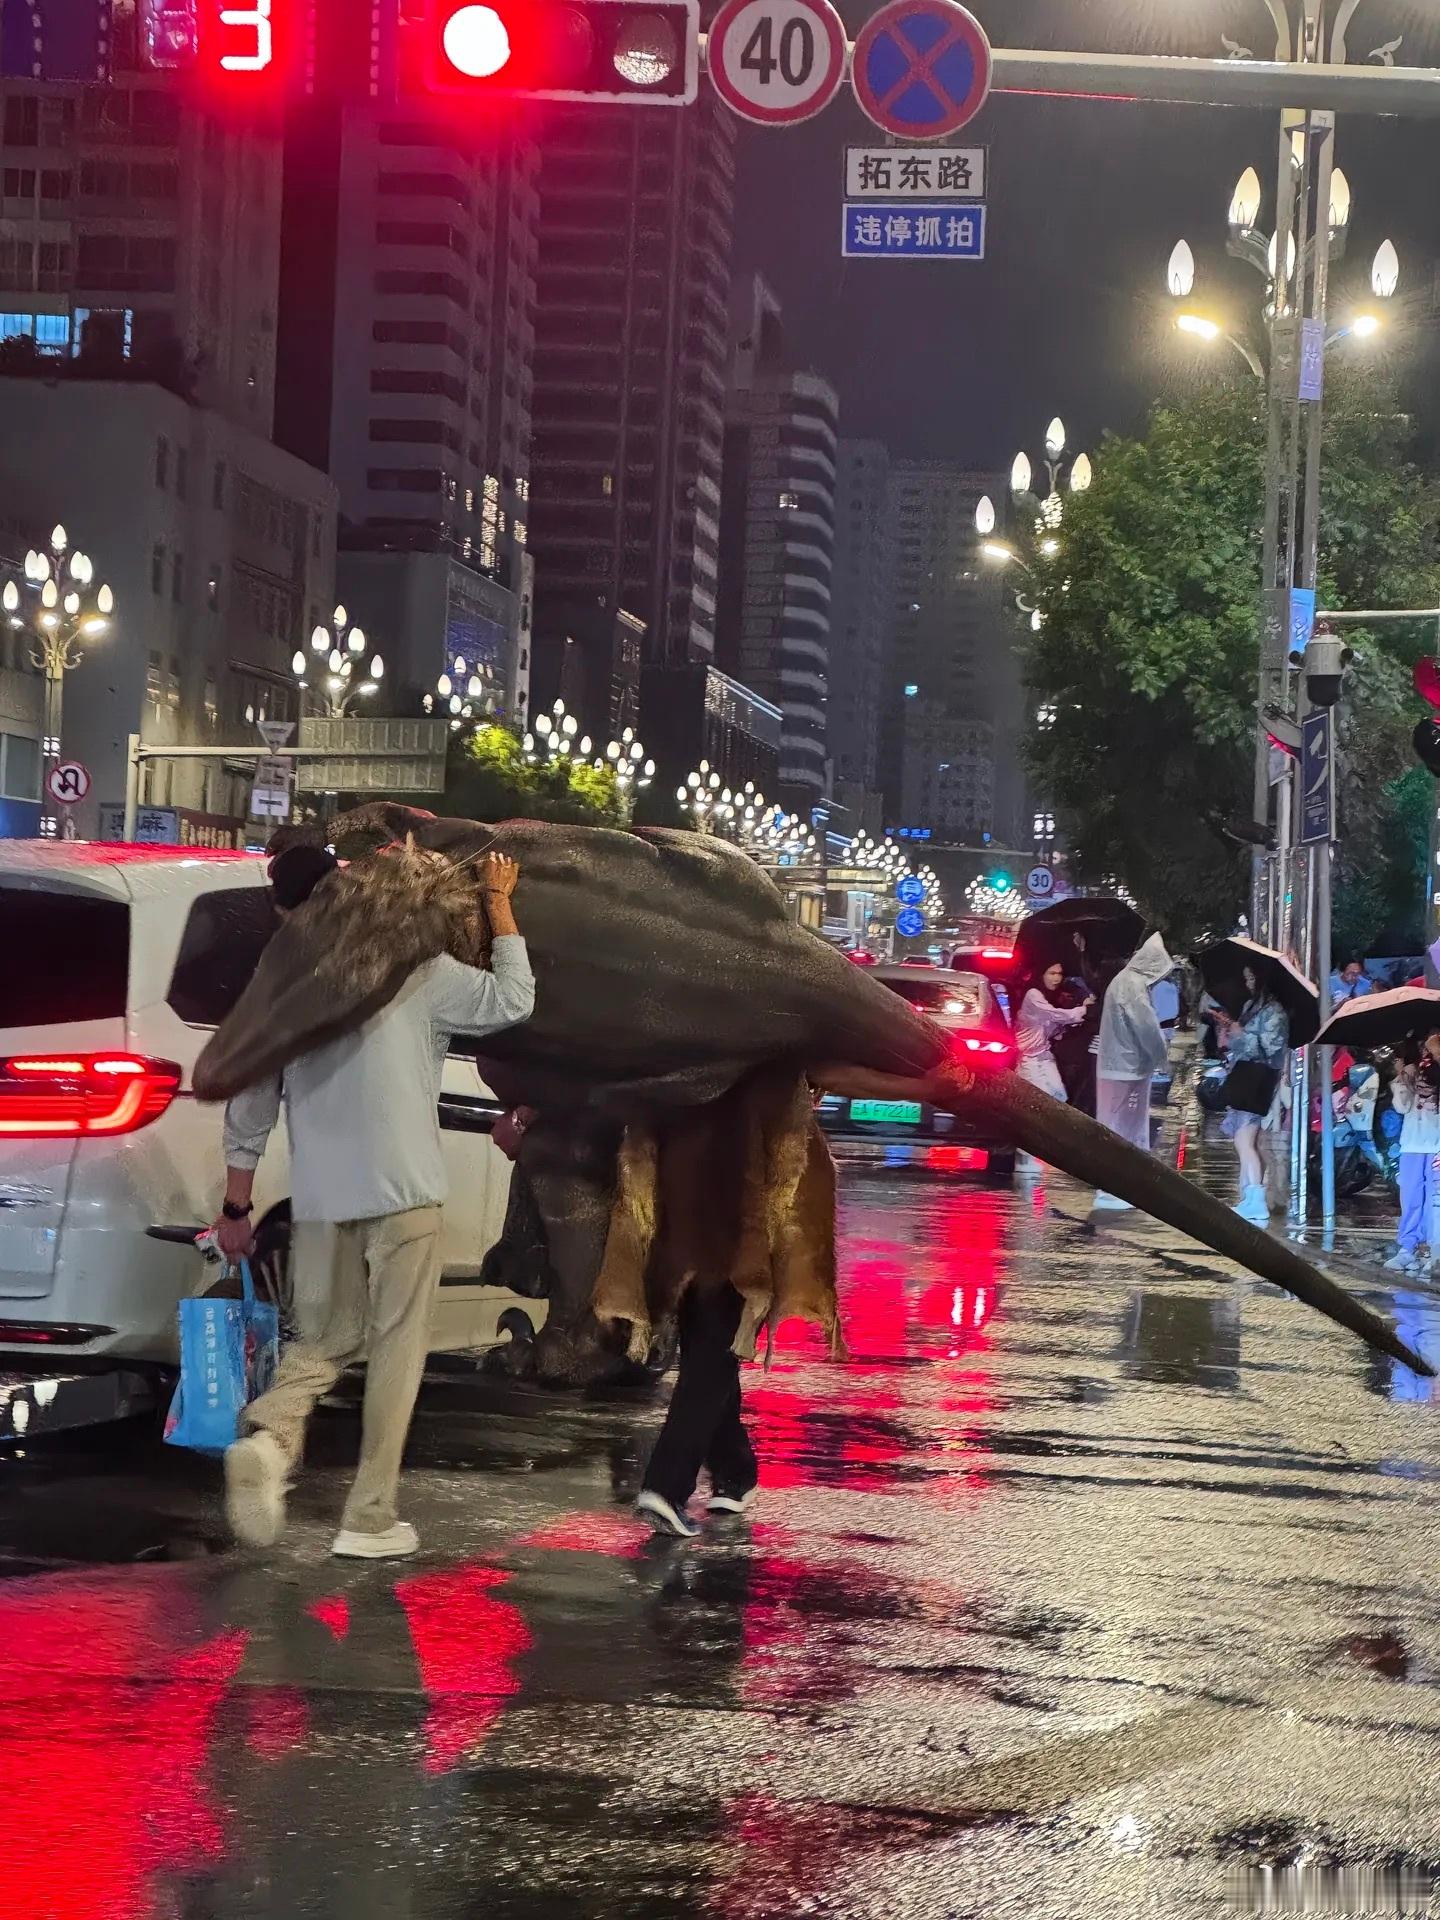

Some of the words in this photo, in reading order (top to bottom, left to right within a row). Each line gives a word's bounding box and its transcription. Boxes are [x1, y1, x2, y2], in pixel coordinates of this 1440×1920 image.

[219, 0, 273, 71] 3
[741, 16, 814, 86] 40
[858, 155, 973, 191] 拓东路
[854, 215, 974, 248] 违停抓拍
[1031, 873, 1049, 888] 30
